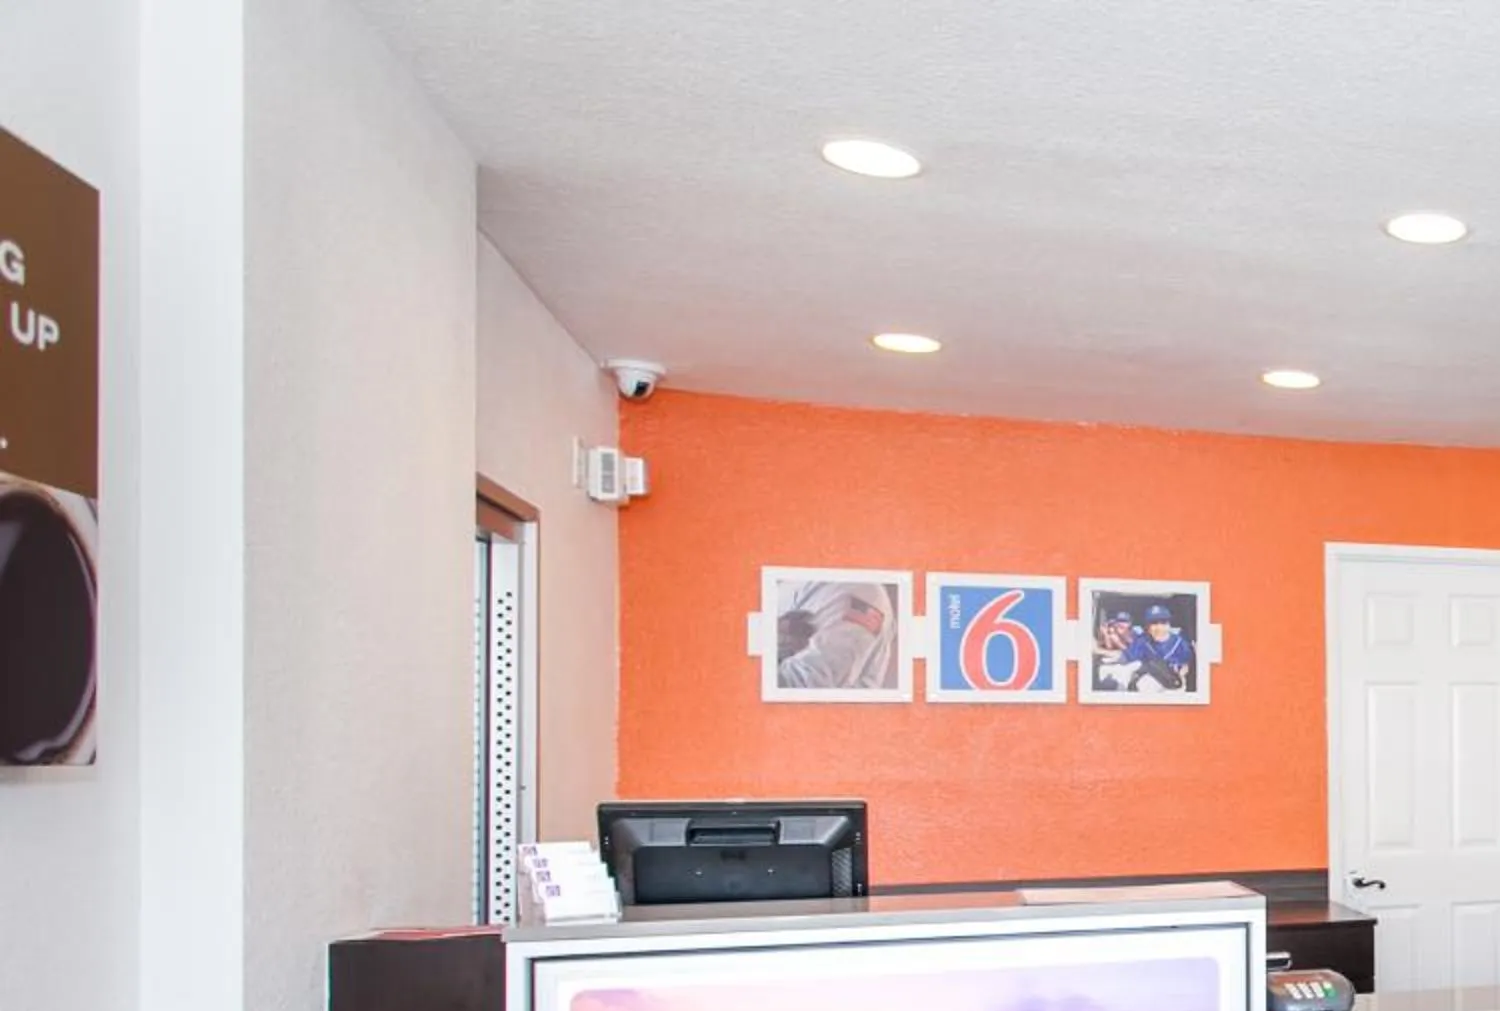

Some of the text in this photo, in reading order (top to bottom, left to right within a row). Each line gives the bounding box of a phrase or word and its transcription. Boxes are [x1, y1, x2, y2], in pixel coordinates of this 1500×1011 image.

[11, 301, 60, 352] UP
[949, 593, 961, 629] motel
[960, 588, 1040, 691] 6
